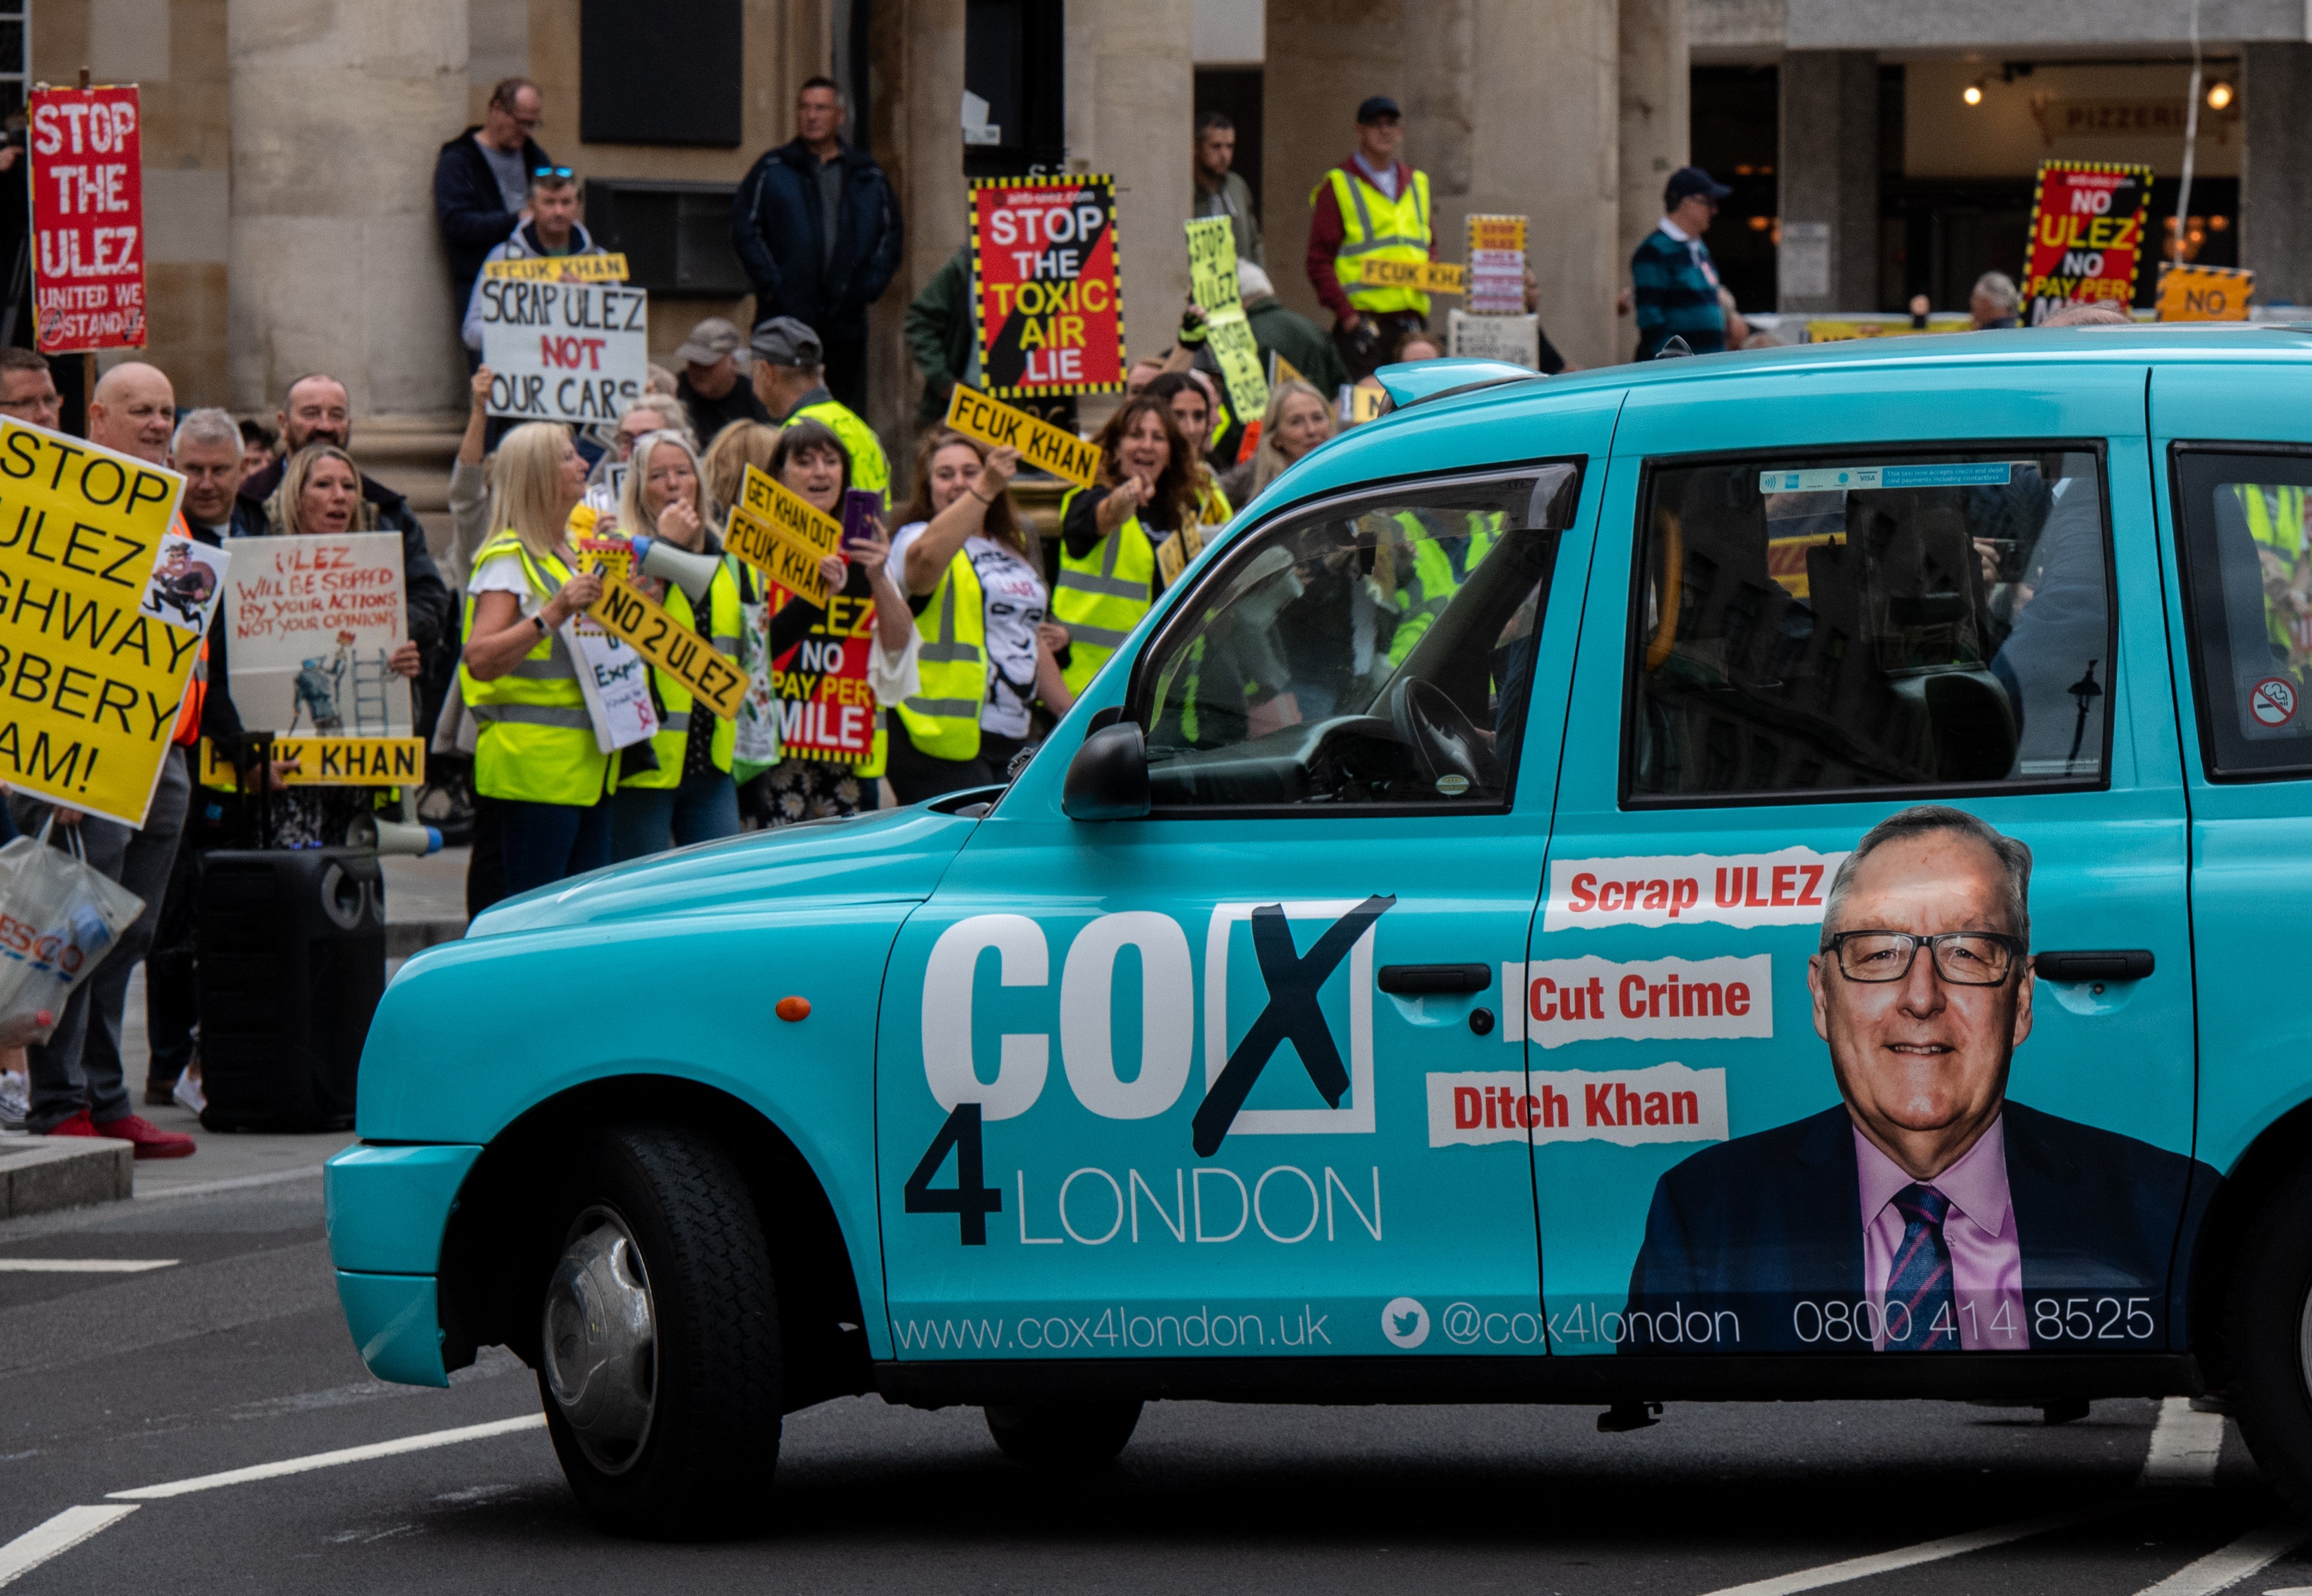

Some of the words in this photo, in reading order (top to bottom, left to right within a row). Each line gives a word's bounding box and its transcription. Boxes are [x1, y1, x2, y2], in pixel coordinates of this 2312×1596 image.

[35, 102, 136, 156] STOP
[50, 165, 129, 214] THE
[2070, 189, 2112, 215] NO
[991, 206, 1104, 246] STOP
[2041, 213, 2137, 251] ULEZ
[40, 227, 139, 278] ULEZ
[1011, 248, 1081, 280] THE
[2063, 251, 2105, 278] NO
[39, 284, 108, 309] UNITED
[114, 282, 143, 306] WE
[482, 280, 558, 325] SCRAP
[565, 287, 647, 334] ULEZ
[989, 279, 1108, 316] TOXIC
[2031, 275, 2078, 298] PAY
[2078, 278, 2128, 301] PER
[2185, 290, 2226, 315] NO
[65, 312, 123, 338] STAND
[1019, 316, 1087, 351] AIR
[541, 334, 607, 371] NOT
[1026, 348, 1083, 382] LIE
[491, 373, 548, 415] OUR
[955, 395, 1022, 445] FCUK
[1027, 427, 1094, 478] KHAN
[0, 431, 169, 515] STOP
[748, 476, 774, 513] GET
[773, 492, 810, 537] KHAN
[809, 516, 836, 552] OUT
[729, 516, 780, 568] FCUK
[272, 598, 324, 617] YOUR
[328, 590, 398, 610] ACTIONS
[290, 573, 315, 596] BE
[0, 570, 202, 674] HWAY
[237, 617, 275, 639] NOT
[278, 614, 319, 642] YOUR
[602, 585, 645, 634] NO
[642, 616, 668, 654] 2
[666, 633, 739, 708] ULEZ
[800, 639, 845, 674] NO
[773, 671, 817, 701] PAY
[821, 675, 871, 708] PER
[775, 698, 866, 748] MILE
[321, 744, 415, 776] KHAN
[1568, 873, 1699, 918] Scrap
[1714, 864, 1824, 908] ULEZ
[1529, 977, 1604, 1022] Cut
[1618, 973, 1751, 1019] Crime
[921, 893, 1397, 1158] COX
[1454, 1085, 1569, 1129] Ditch
[1584, 1083, 1699, 1127] Khan
[904, 1103, 1003, 1247] 4
[1017, 1165, 1382, 1246] LONDON
[894, 1303, 1333, 1350] www.cox4london.uk
[1442, 1300, 1741, 1345] @cox4london
[1794, 1300, 1913, 1342] 0800
[1929, 1299, 2018, 1341] 414
[2035, 1297, 2154, 1341] 8525
